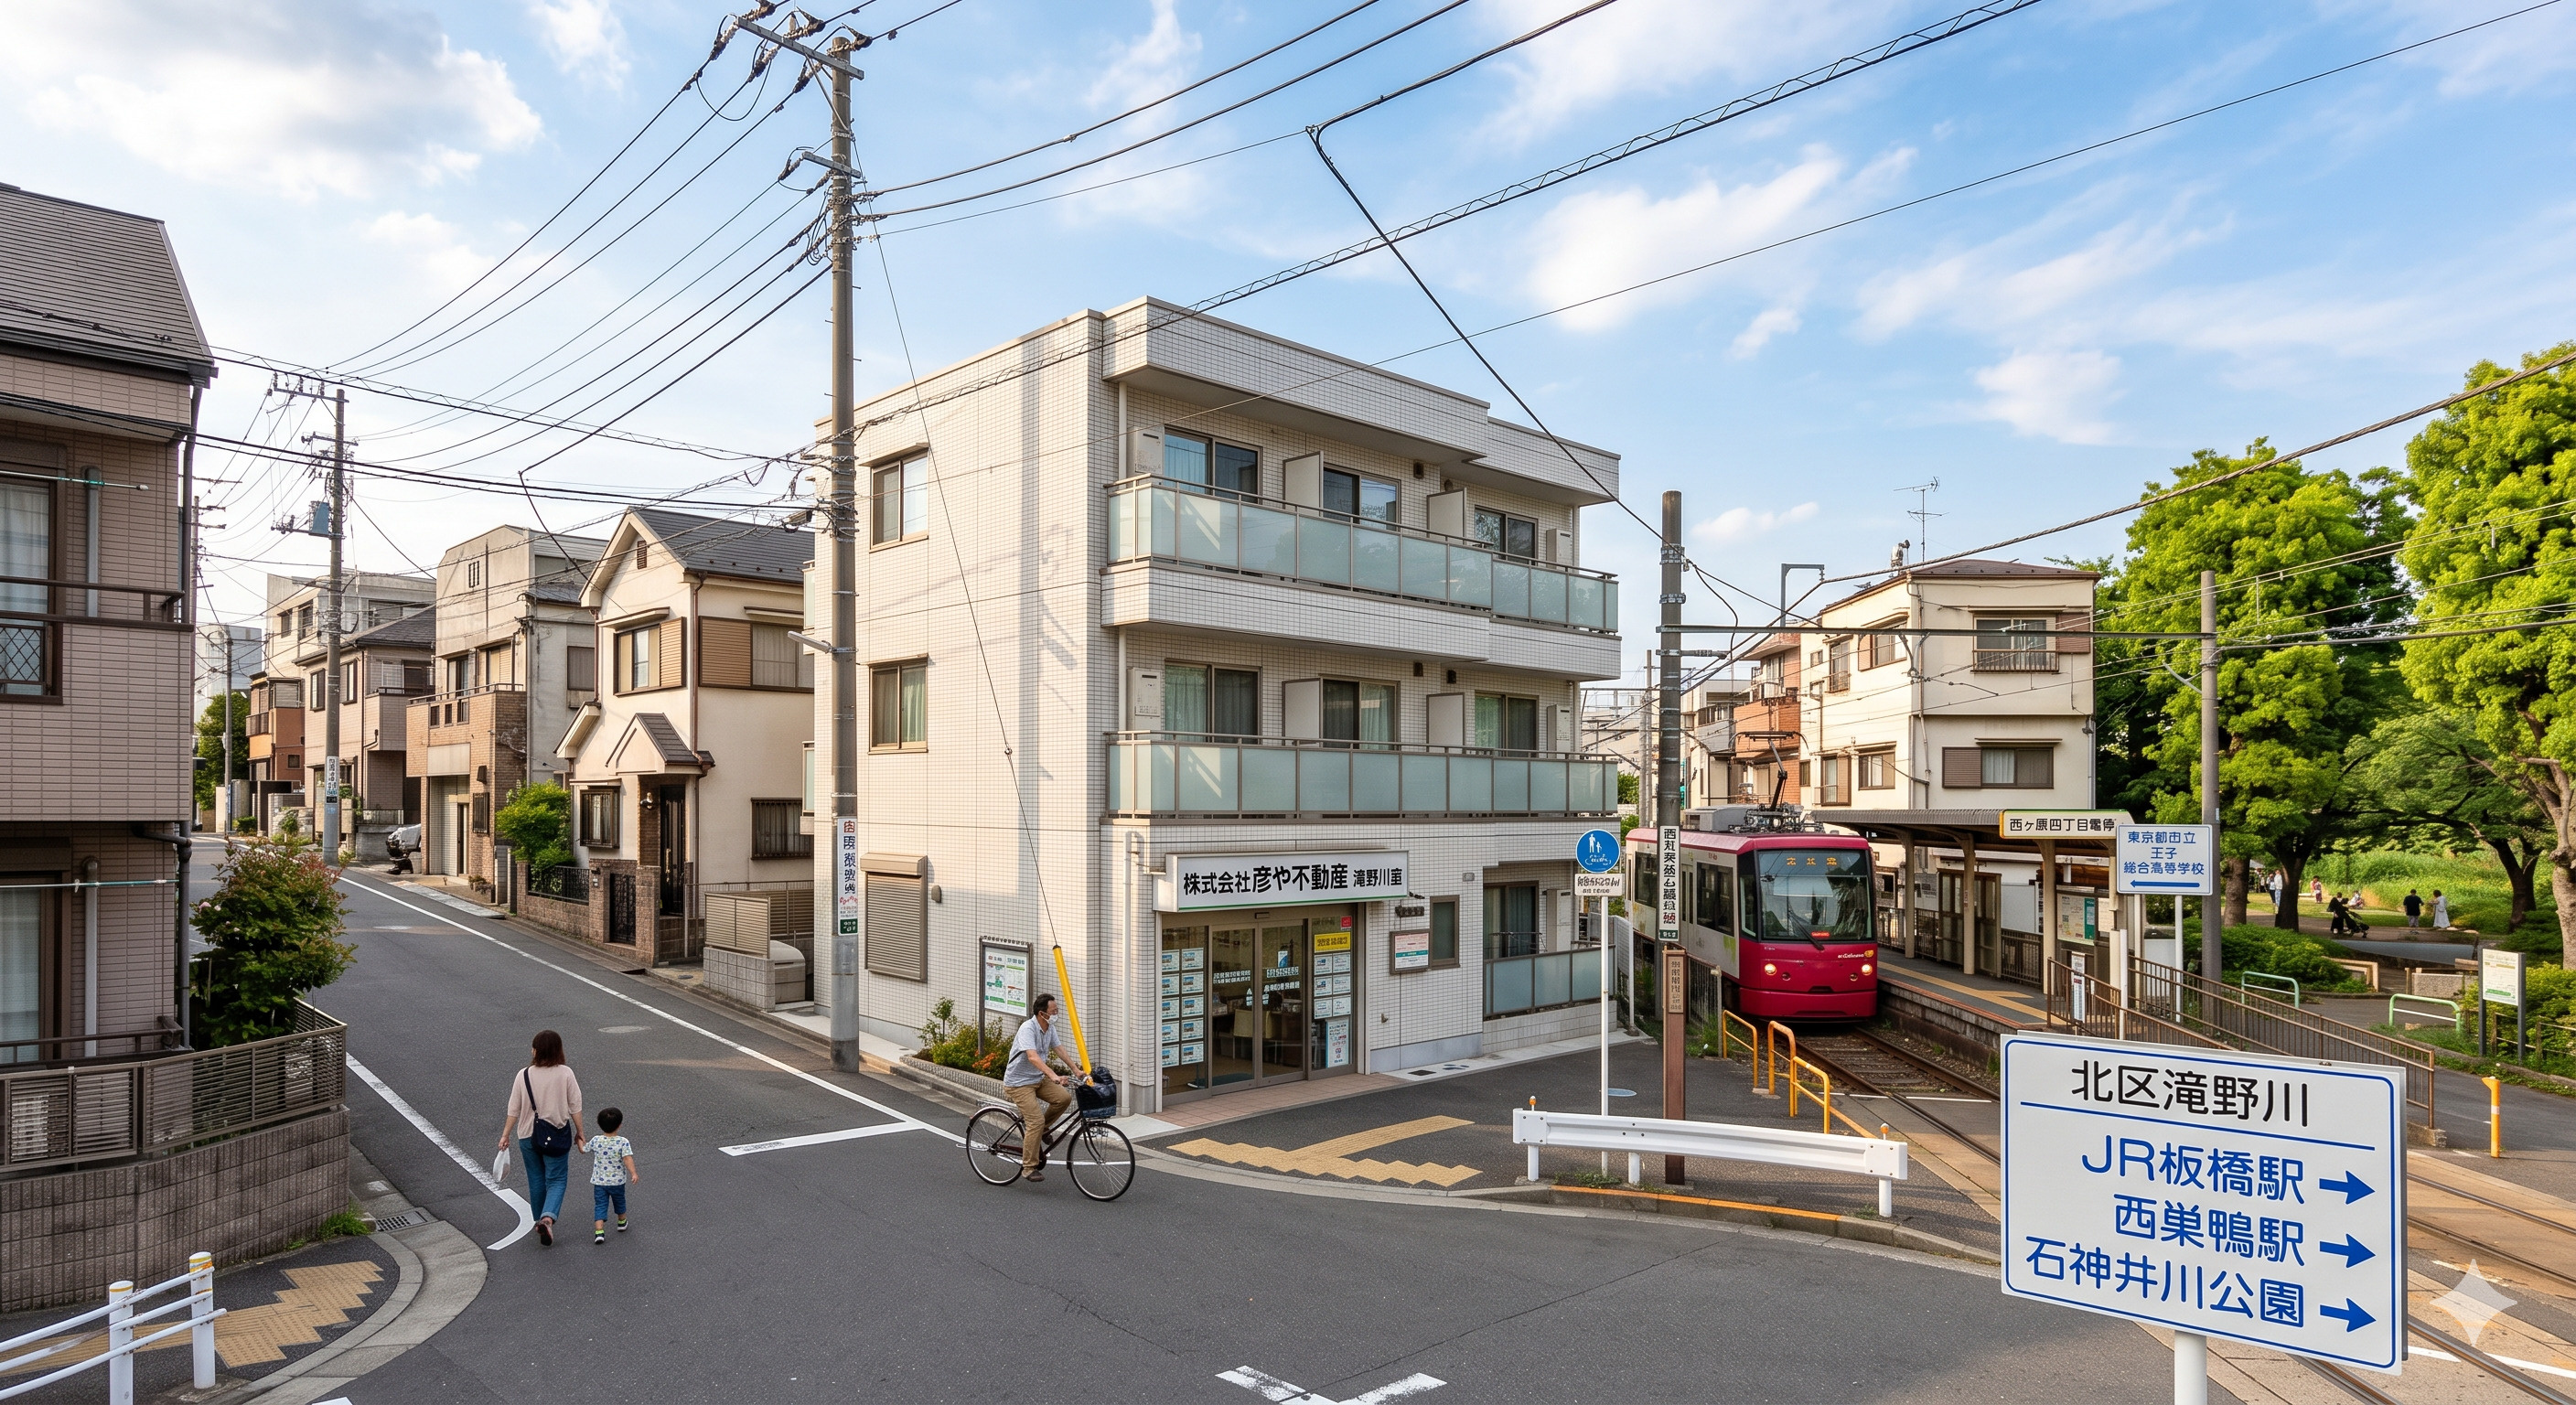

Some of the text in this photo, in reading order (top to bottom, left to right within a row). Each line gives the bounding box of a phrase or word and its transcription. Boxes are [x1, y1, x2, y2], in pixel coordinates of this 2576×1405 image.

[1183, 863, 1348, 896] 株式会社彦や不動産
[2123, 862, 2205, 875] 総合高等学校
[2151, 846, 2177, 860] 王子
[2071, 1059, 2308, 1127] 北区滝野川
[2081, 1134, 2304, 1205] JR板橋駅
[2114, 1193, 2304, 1267] 西巣鴨駅
[2025, 1236, 2304, 1328] 石神井川公園
